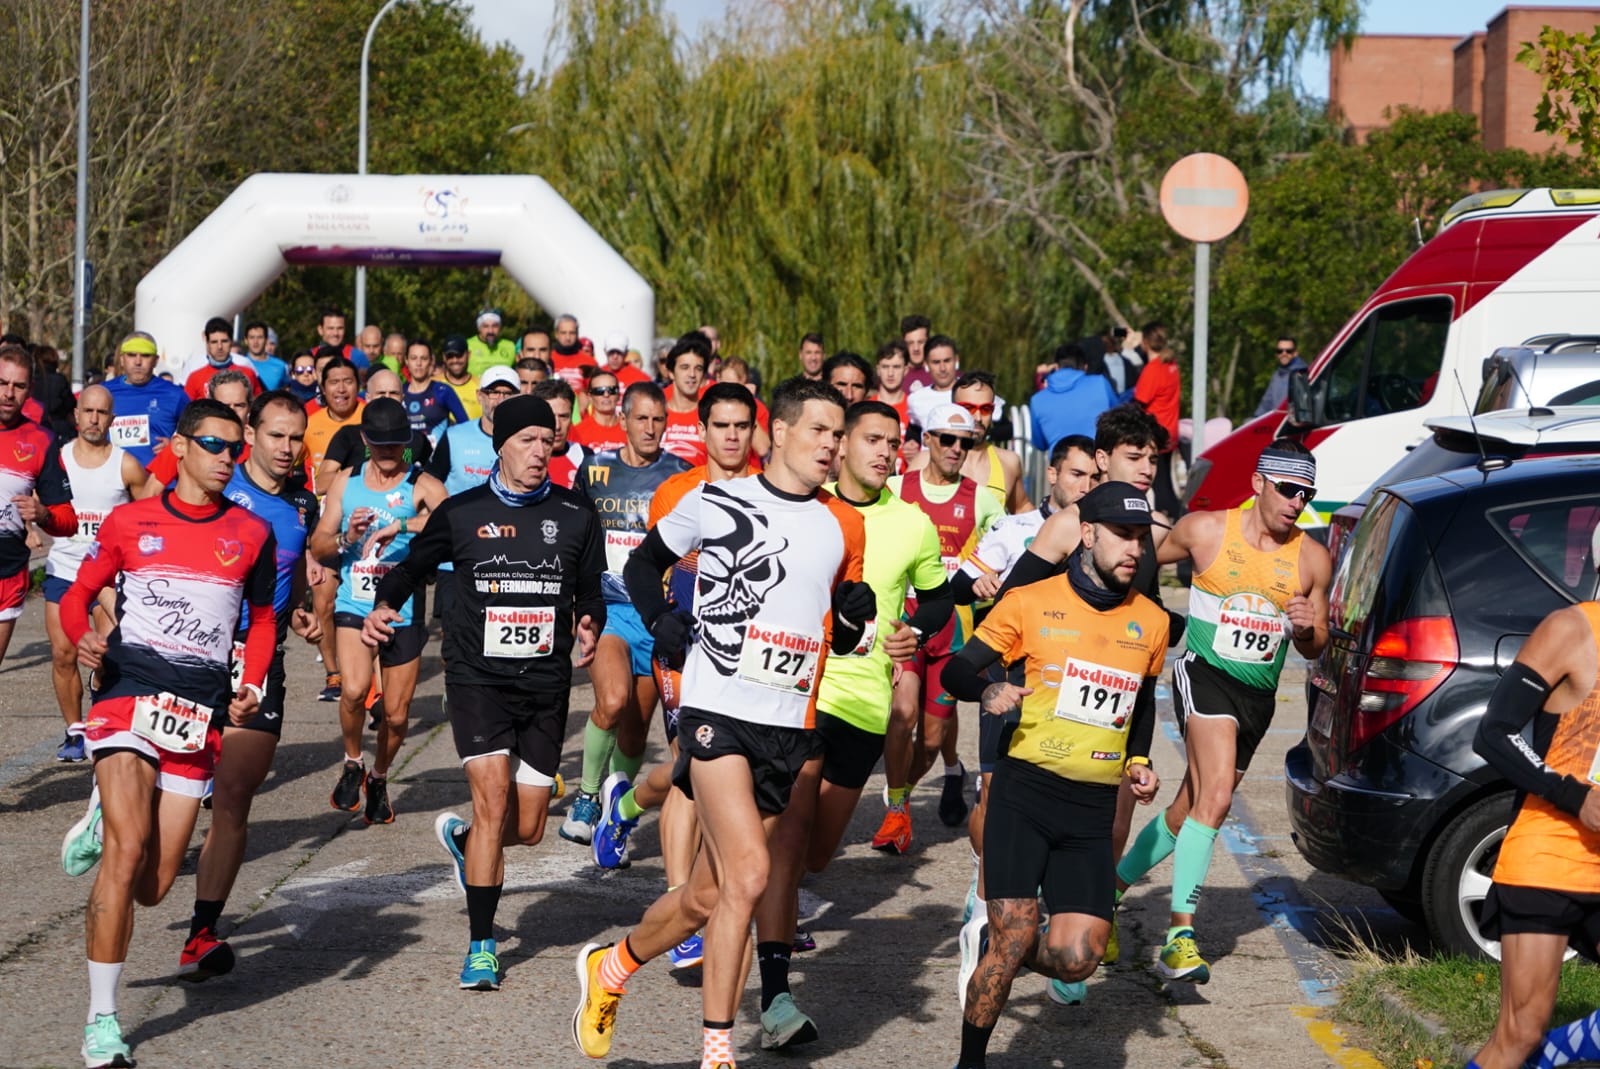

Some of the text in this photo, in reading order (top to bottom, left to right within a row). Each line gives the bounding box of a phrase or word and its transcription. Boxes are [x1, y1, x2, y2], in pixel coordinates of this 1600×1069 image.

[117, 427, 140, 440] 162
[512, 571, 535, 579] CÍVICO
[500, 580, 543, 594] FERNANDO
[488, 610, 553, 624] bedunia
[1220, 613, 1282, 632] bedunia
[500, 625, 541, 645] 258
[747, 624, 819, 653] bedunia
[1232, 629, 1270, 651] 198
[761, 647, 805, 677] 127
[1066, 662, 1140, 692] bedunia
[1080, 684, 1122, 714] 191
[149, 710, 190, 741] 104
